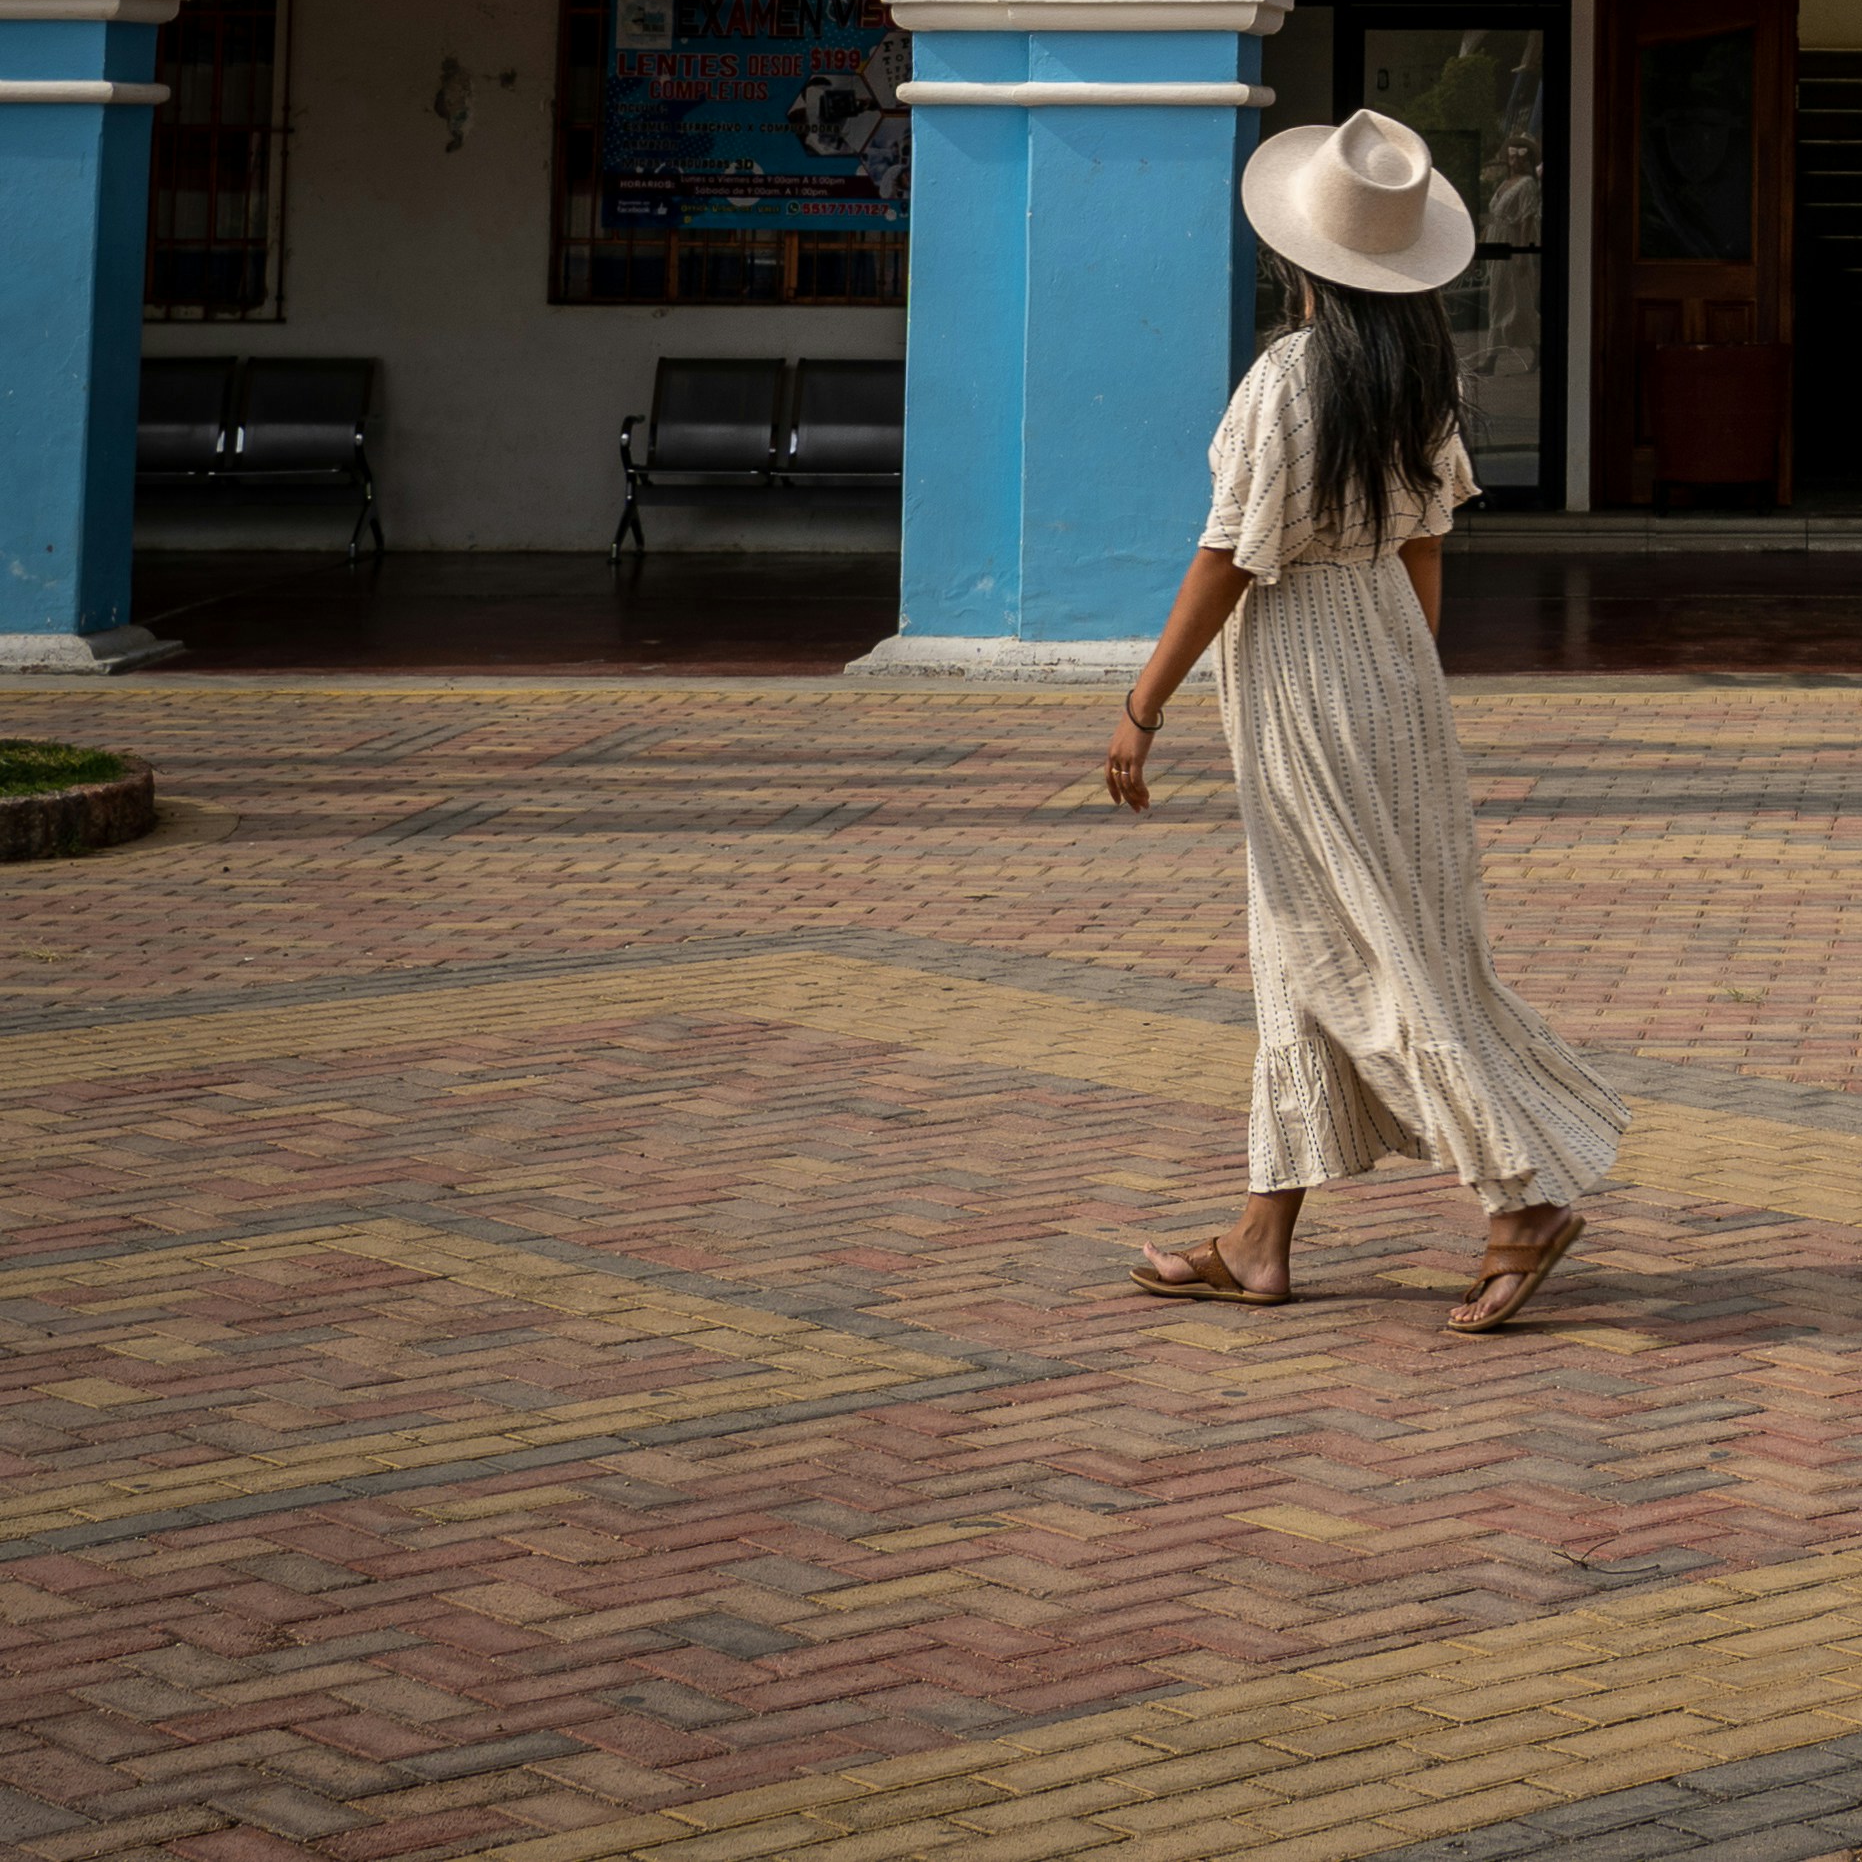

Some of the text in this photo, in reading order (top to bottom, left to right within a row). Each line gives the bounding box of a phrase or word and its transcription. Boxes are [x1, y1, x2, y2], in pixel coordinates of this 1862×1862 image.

[617, 47, 862, 78] LENTES DESDE $199
[649, 79, 769, 101] COMPLETOS
